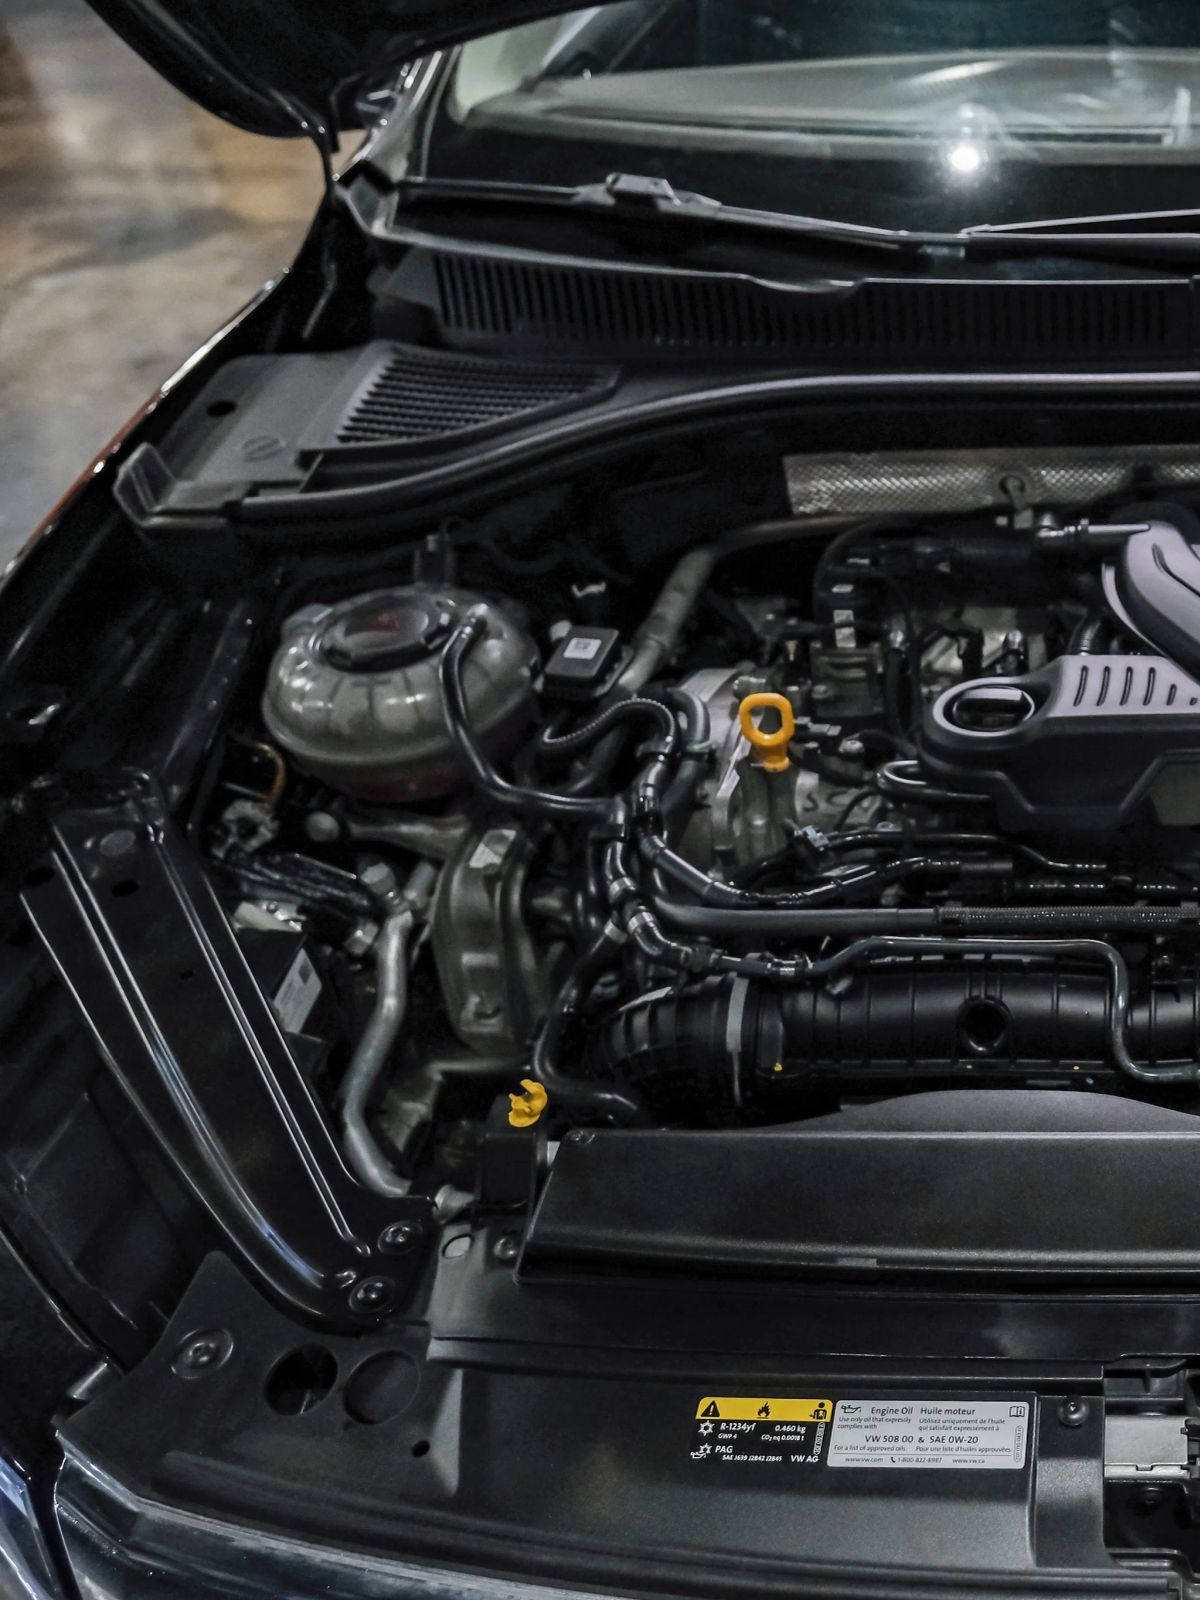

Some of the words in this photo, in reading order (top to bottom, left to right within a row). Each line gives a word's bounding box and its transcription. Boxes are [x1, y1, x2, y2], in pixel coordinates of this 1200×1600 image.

[871, 1407, 899, 1416] Engine
[921, 1407, 942, 1415] Huile
[720, 1422, 756, 1432] R-1234yf
